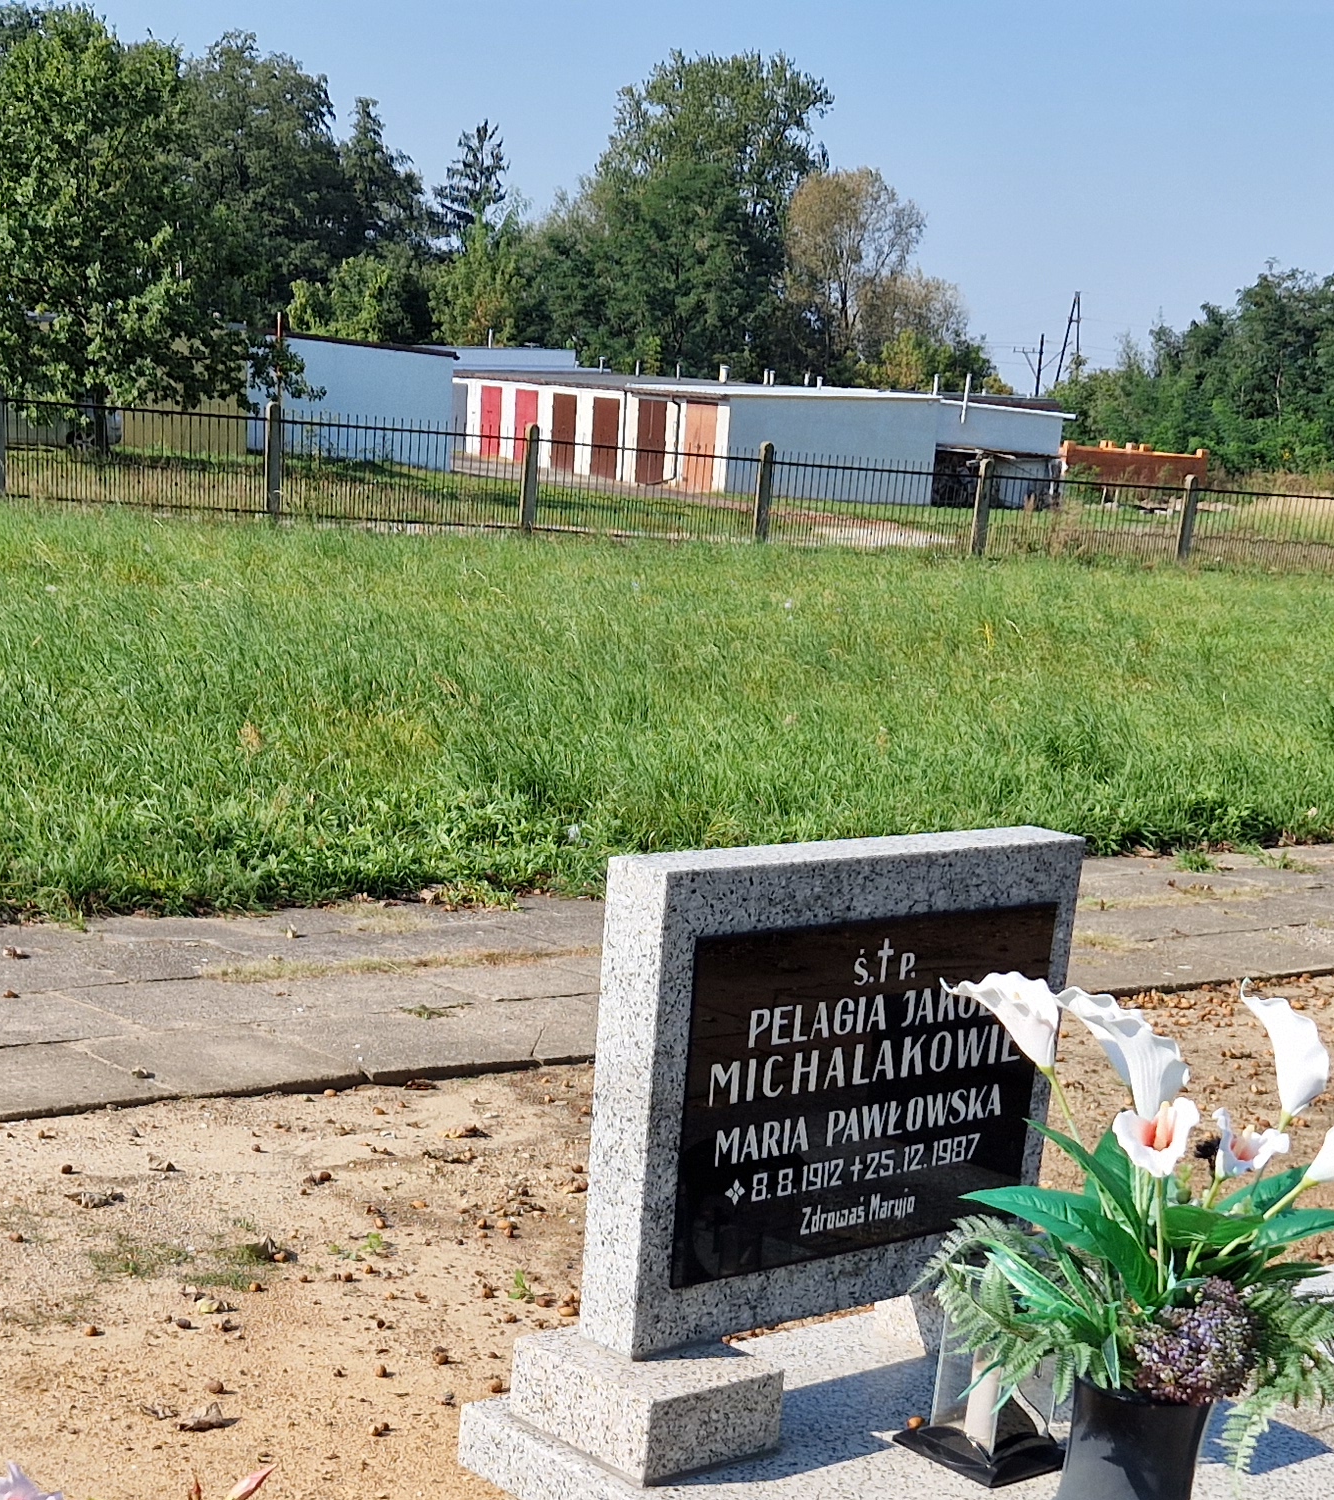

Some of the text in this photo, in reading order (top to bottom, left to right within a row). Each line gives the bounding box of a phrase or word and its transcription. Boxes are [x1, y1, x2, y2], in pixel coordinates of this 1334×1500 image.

[747, 993, 887, 1049] PELAGIA
[714, 1084, 1002, 1168] MARIA PAWŁOWSKA
[799, 1187, 916, 1236] Zdrowaś Maryjo
